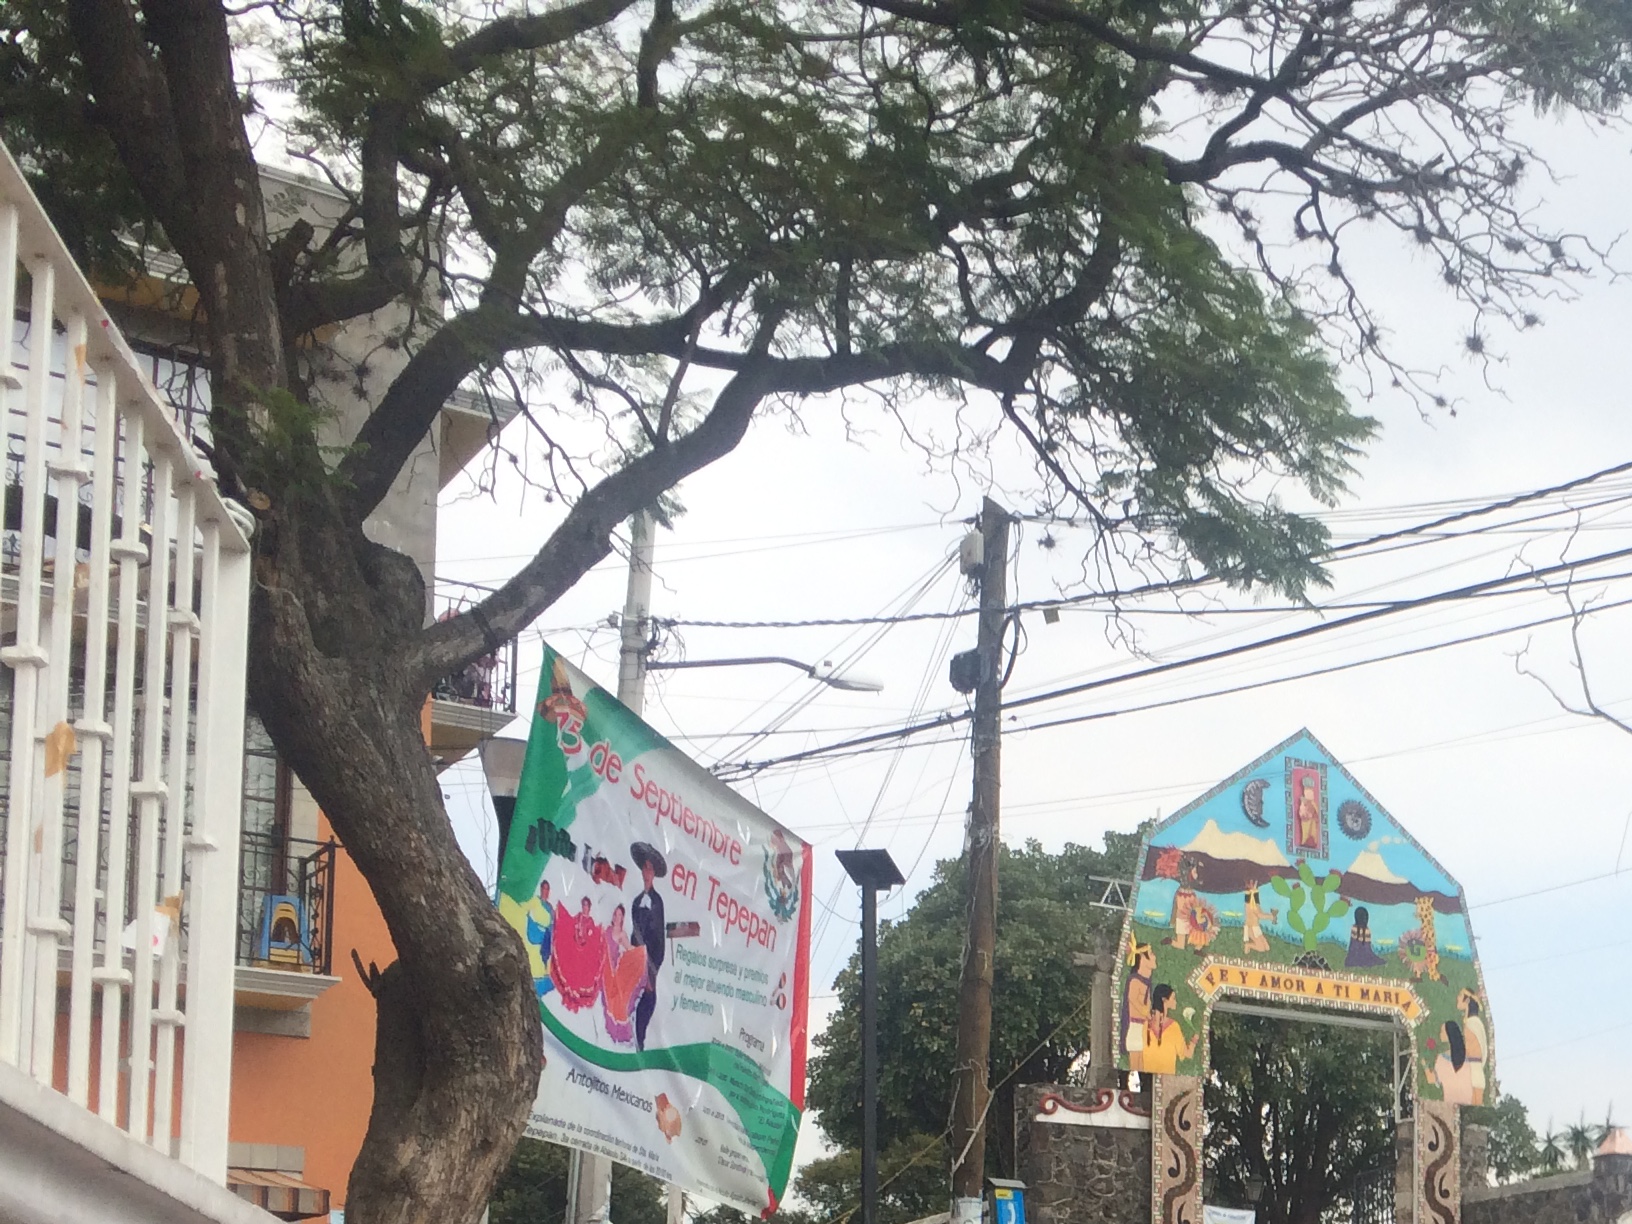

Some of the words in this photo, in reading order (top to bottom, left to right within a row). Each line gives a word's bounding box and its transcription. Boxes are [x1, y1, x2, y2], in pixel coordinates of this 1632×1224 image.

[556, 711, 584, 755] 15
[589, 741, 623, 784] de
[630, 763, 743, 866] Septiembre
[671, 862, 698, 901] en
[707, 875, 778, 953] Tepepan
[676, 943, 707, 967] Regalos
[1206, 968, 1229, 987] FE
[1239, 971, 1249, 985] Y
[1259, 974, 1306, 993] AMOR
[1315, 981, 1325, 995] A
[1333, 984, 1350, 998] TI
[1360, 986, 1412, 1014] MARIA
[566, 1068, 609, 1093] Antojitos
[611, 1084, 653, 1113] Mexicanos
